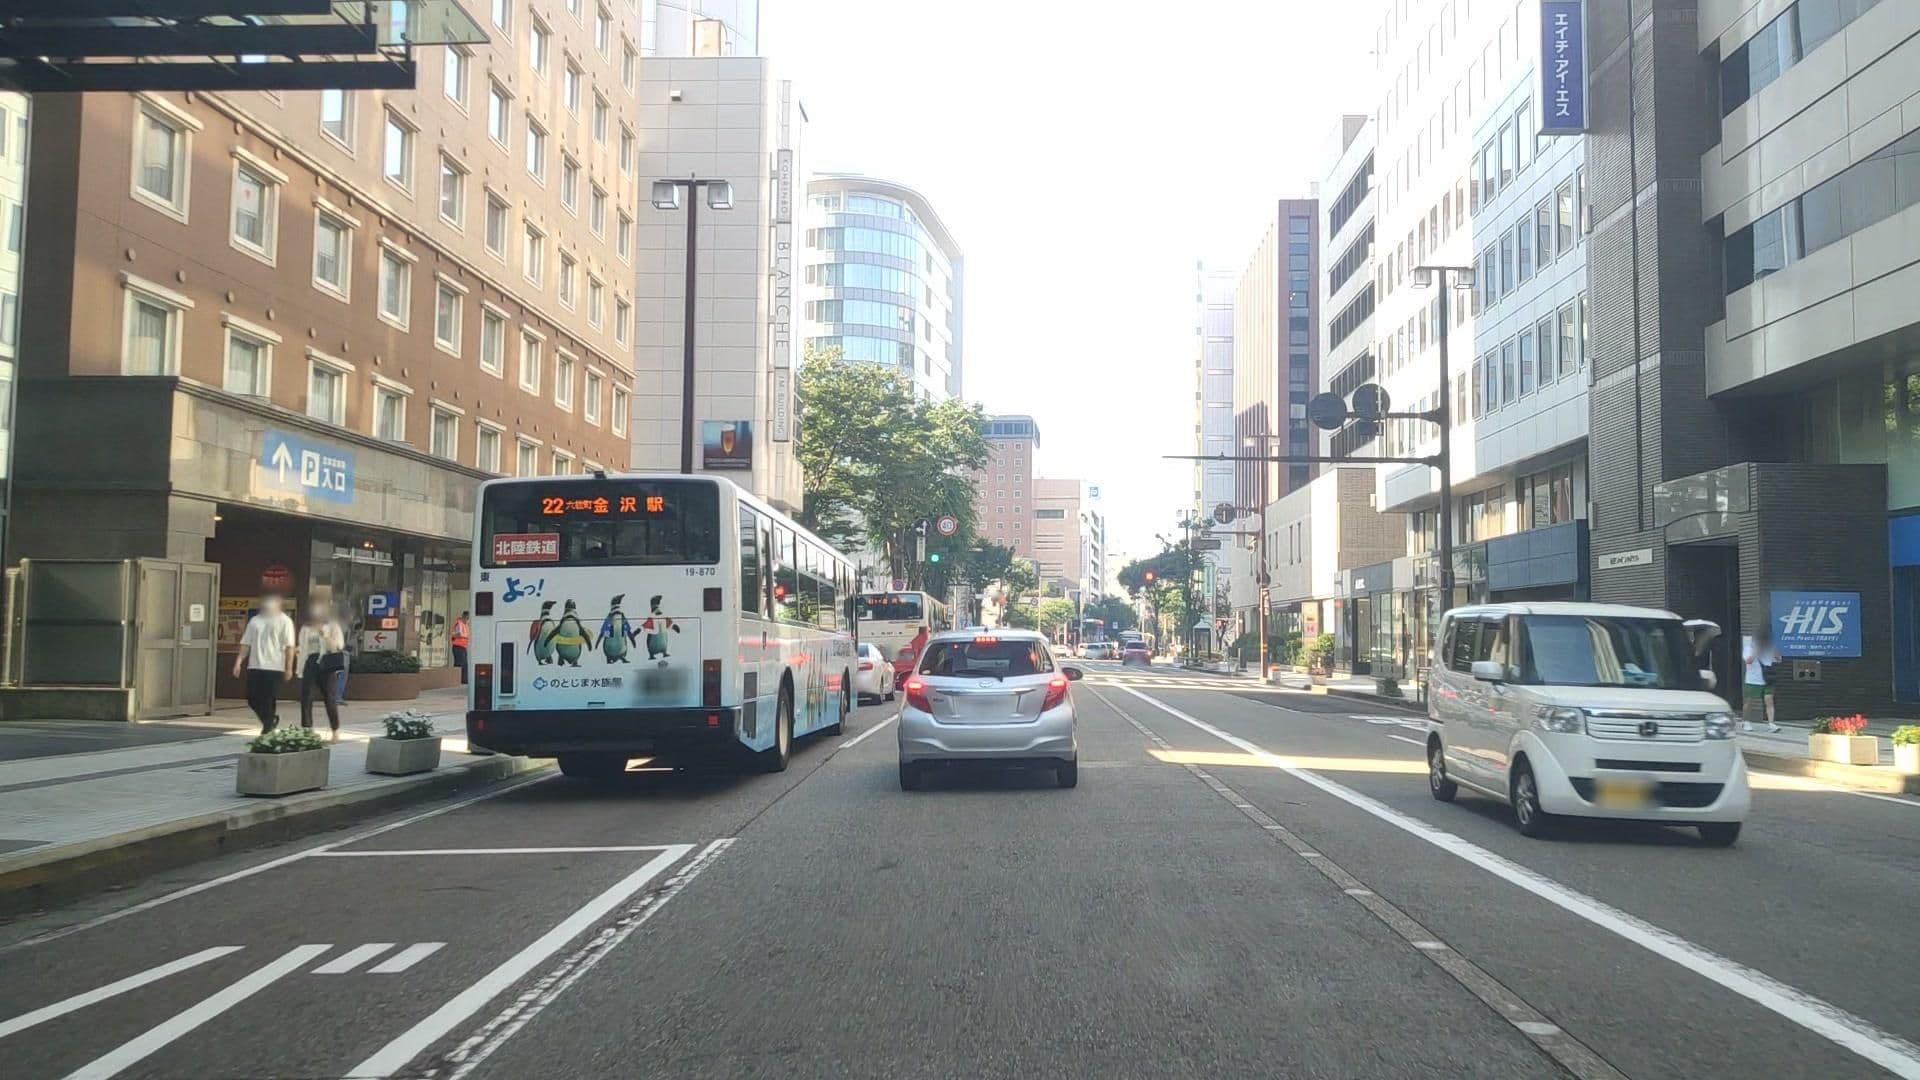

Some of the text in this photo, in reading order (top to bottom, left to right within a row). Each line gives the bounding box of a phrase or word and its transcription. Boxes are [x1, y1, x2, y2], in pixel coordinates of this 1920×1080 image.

[1554, 13, 1570, 117] エイチ・アイ・エス
[776, 241, 791, 348] BLANCHE
[321, 468, 346, 493] 入口
[542, 497, 565, 514] 22
[593, 497, 664, 514] 金沢駅
[495, 540, 557, 556] 北陸鉄道
[685, 567, 716, 577] 19-870
[367, 594, 388, 615] P
